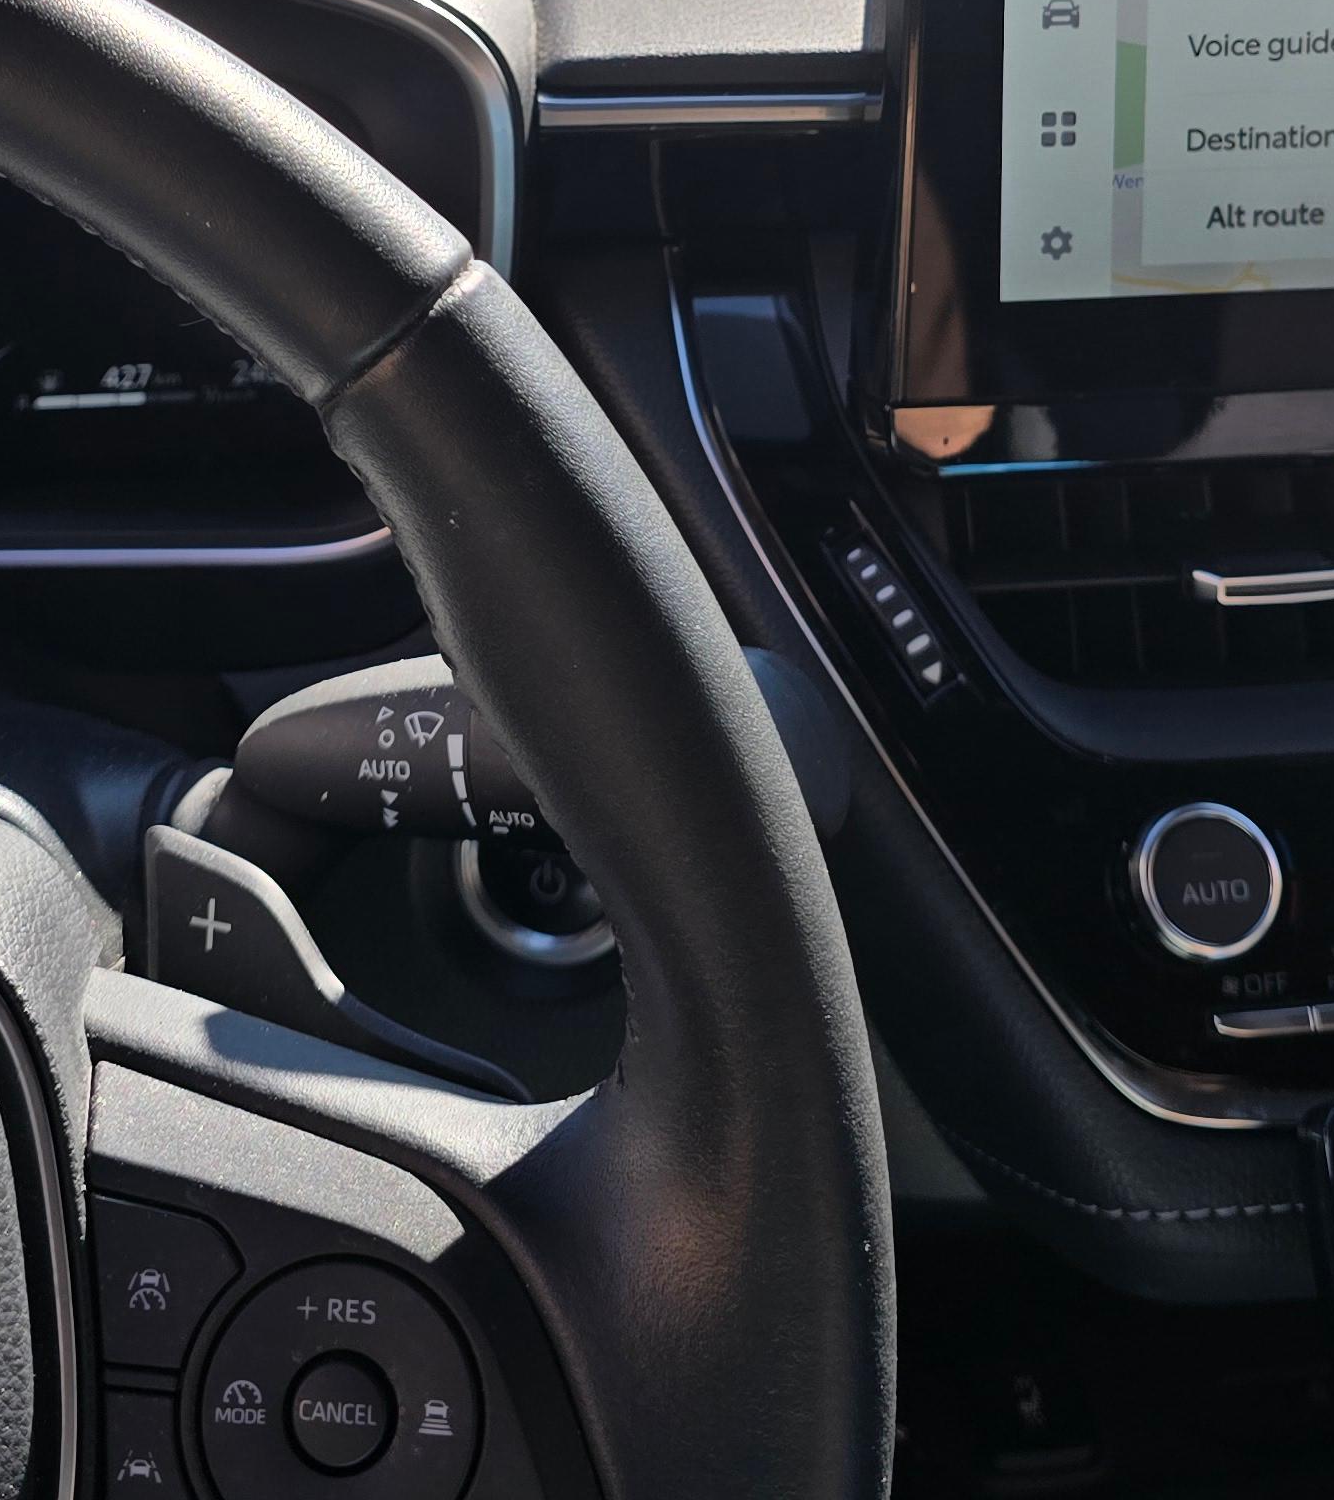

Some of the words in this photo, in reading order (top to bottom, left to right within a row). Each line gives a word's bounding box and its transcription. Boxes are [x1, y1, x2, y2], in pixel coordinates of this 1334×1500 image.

[1188, 32, 1262, 58] Voice
[1206, 202, 1247, 230] Alt
[1252, 201, 1326, 229] route
[99, 362, 154, 390] 427
[357, 758, 412, 782] AUTO
[488, 809, 535, 831] AUTO
[1182, 877, 1250, 906] AUTO
[1243, 971, 1288, 995] OFF
[327, 1298, 378, 1325] RES
[214, 1406, 267, 1426] MODE
[298, 1399, 378, 1428] CANCEL
